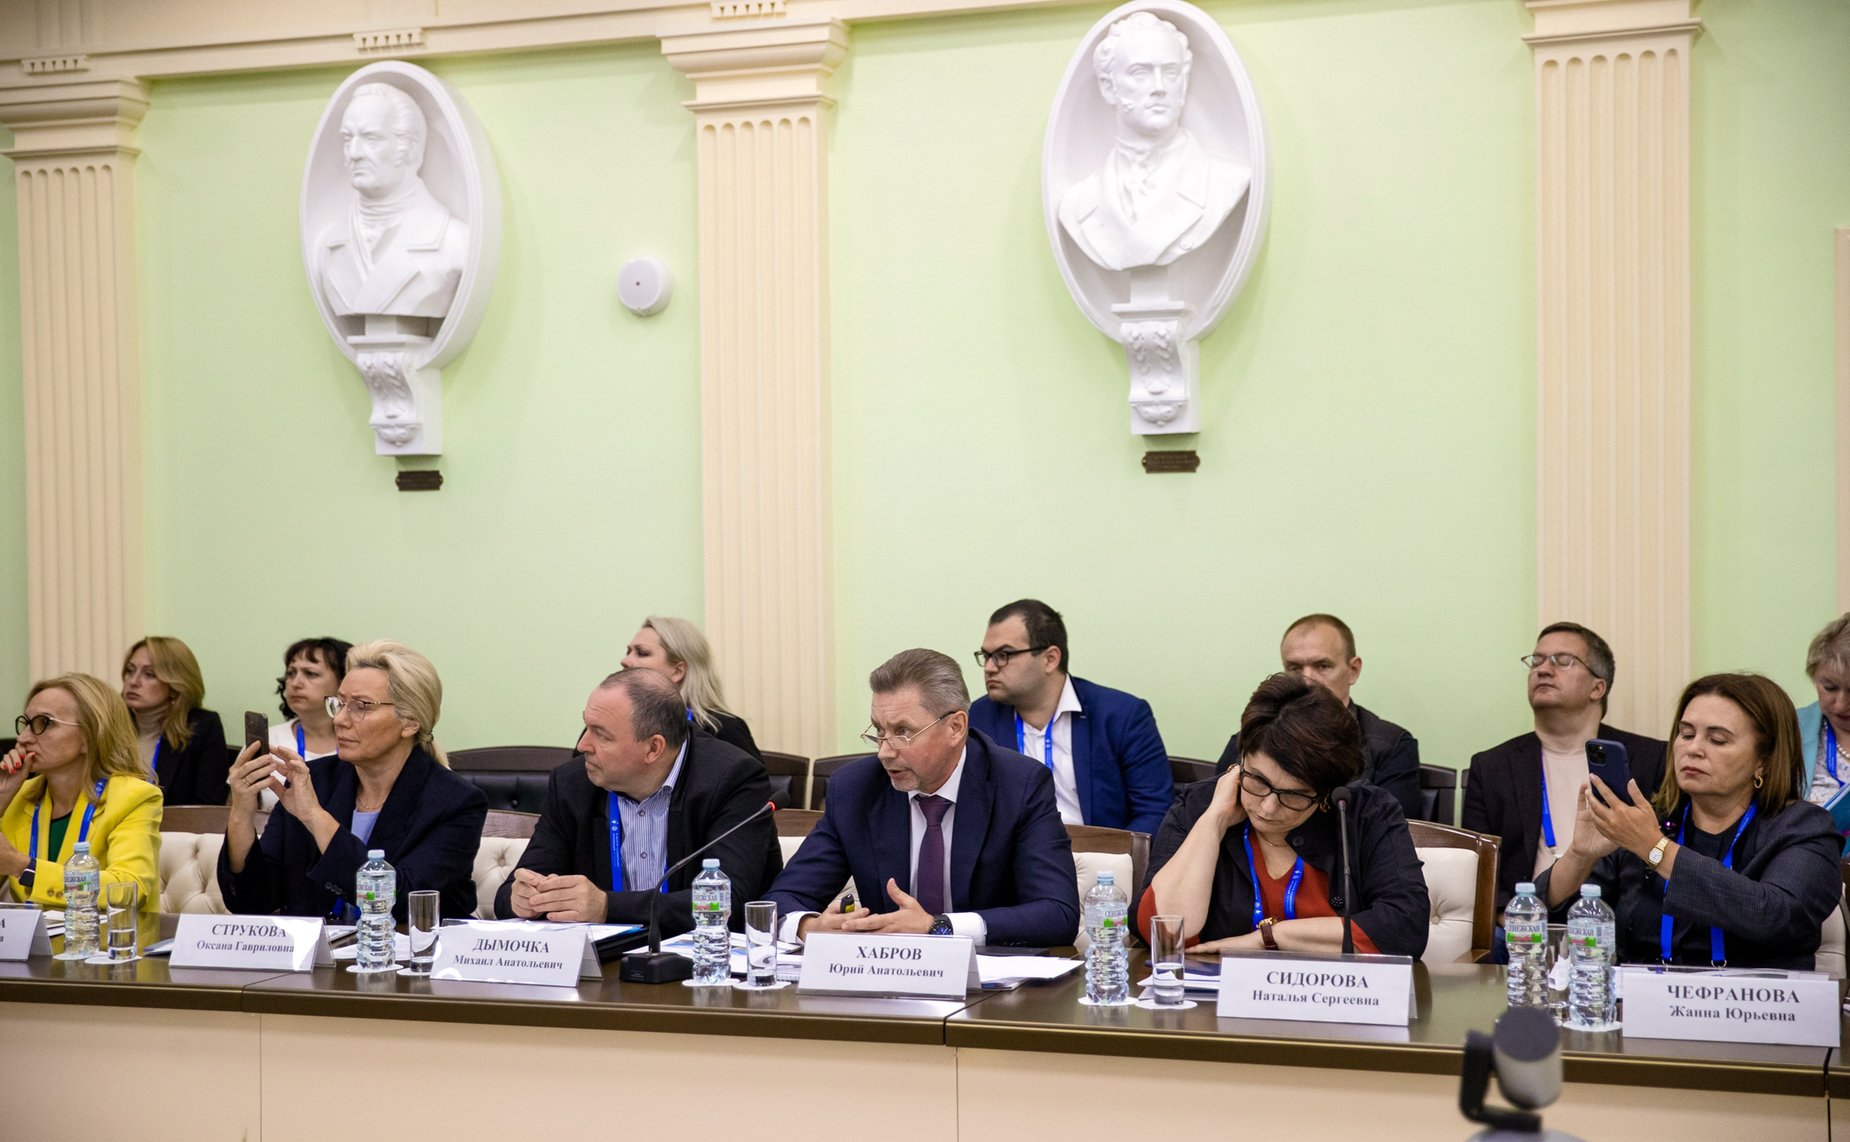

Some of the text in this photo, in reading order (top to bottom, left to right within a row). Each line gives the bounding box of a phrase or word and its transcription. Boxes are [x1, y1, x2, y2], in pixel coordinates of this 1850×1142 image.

[212, 923, 287, 938] СТРУКОВА
[196, 940, 295, 954] Оксана Гавриловна
[472, 938, 550, 953] ДЫМОЧКА
[856, 946, 923, 960] ХАБРОВ
[453, 954, 563, 970] Михаил Анатольевич
[829, 963, 944, 978] Юрий Анатольевич
[1266, 971, 1369, 988] СИДОРОВА
[1252, 990, 1380, 1007] Наталья Сергеевна
[1667, 985, 1801, 1004] ЧЕФРАНОВА
[1669, 1005, 1796, 1023] Жанна Юрьевна
